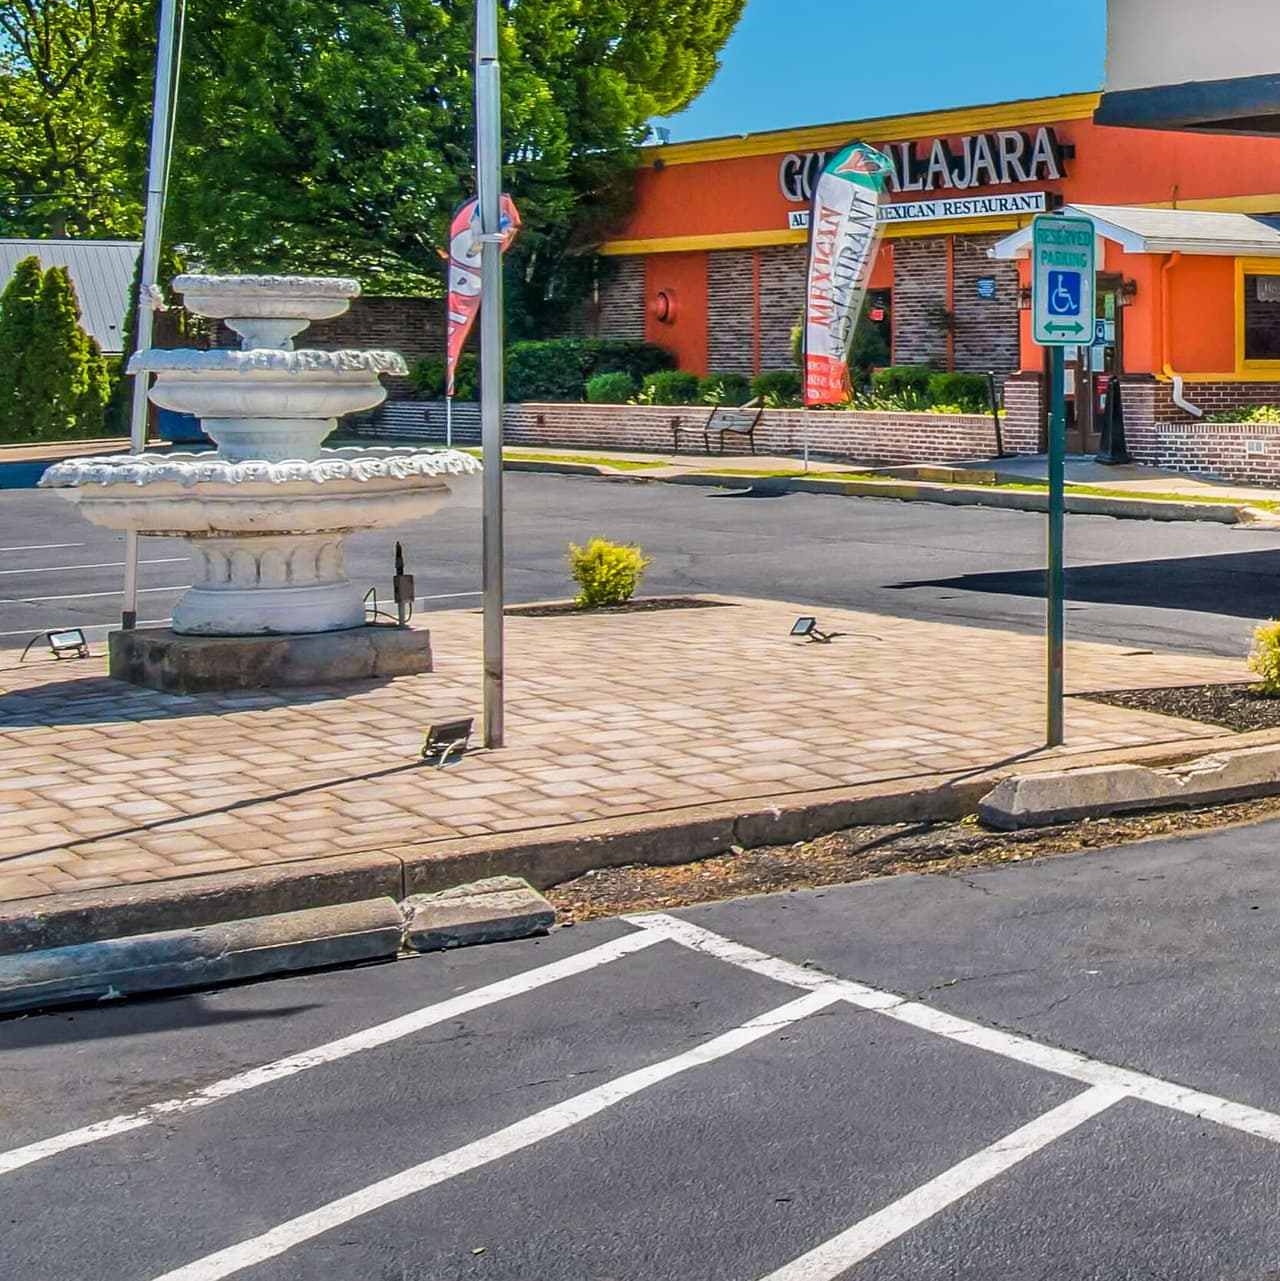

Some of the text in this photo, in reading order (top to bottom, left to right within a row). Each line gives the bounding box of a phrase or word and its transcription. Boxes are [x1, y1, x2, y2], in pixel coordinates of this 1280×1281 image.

[779, 127, 1063, 202] GUALAJARA
[943, 195, 1043, 216] RESTAURANT
[1037, 228, 1090, 247] RESERVED
[809, 205, 843, 330] MEXICAN
[1041, 250, 1088, 268] PARKING
